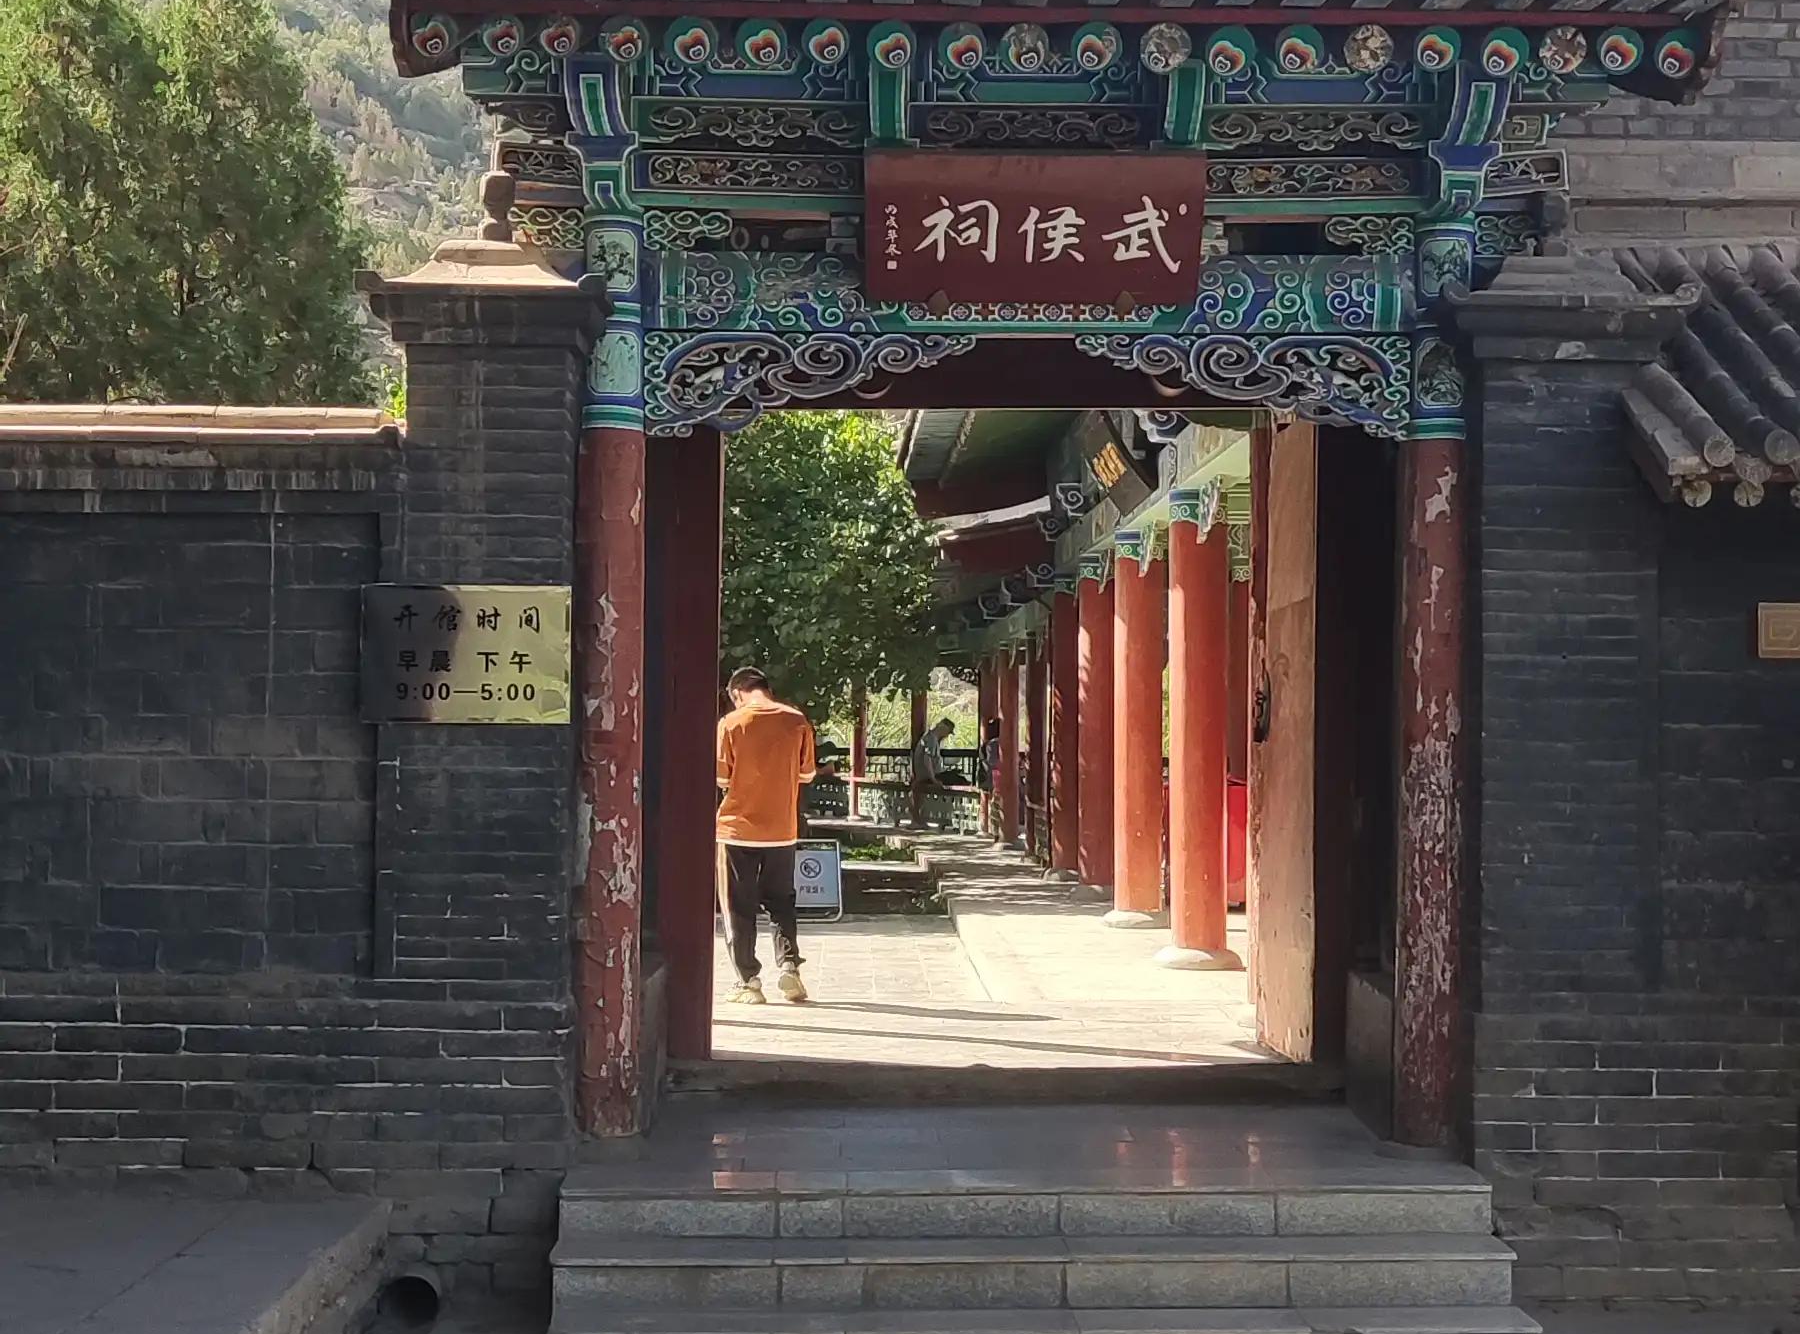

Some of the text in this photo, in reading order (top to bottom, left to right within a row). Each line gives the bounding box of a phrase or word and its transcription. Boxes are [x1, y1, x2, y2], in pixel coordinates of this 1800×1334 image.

[913, 195, 1182, 274] 武侯祠
[393, 604, 542, 634] 开馆时间
[397, 650, 533, 673] 早晨 下午
